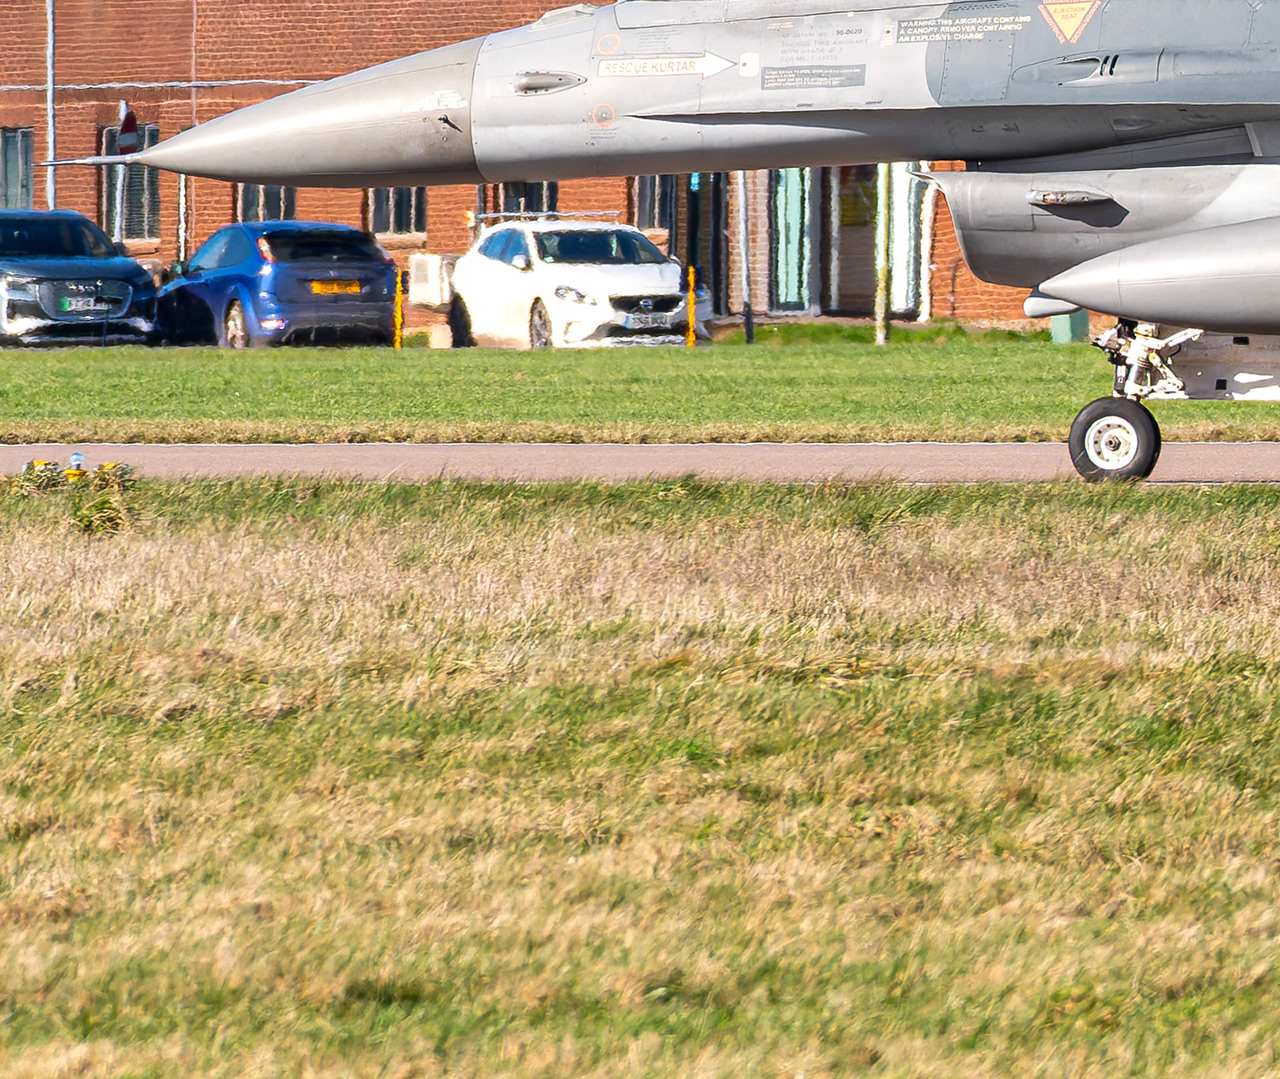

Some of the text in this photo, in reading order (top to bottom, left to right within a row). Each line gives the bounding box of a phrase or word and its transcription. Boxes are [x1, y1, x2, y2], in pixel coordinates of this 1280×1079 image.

[1053, 6, 1086, 14] EJECTION
[937, 18, 953, 26] THIS
[954, 17, 992, 25] AIRCRAFT
[993, 15, 1032, 23] CONTAINS
[907, 27, 939, 35] CANOPY
[940, 25, 976, 33] REMOVER
[977, 24, 1023, 32] CONTAINING
[911, 33, 952, 41] EXPLOSIVE
[953, 32, 985, 40] CHARGE
[605, 60, 696, 73] RESCUE KURTAR
